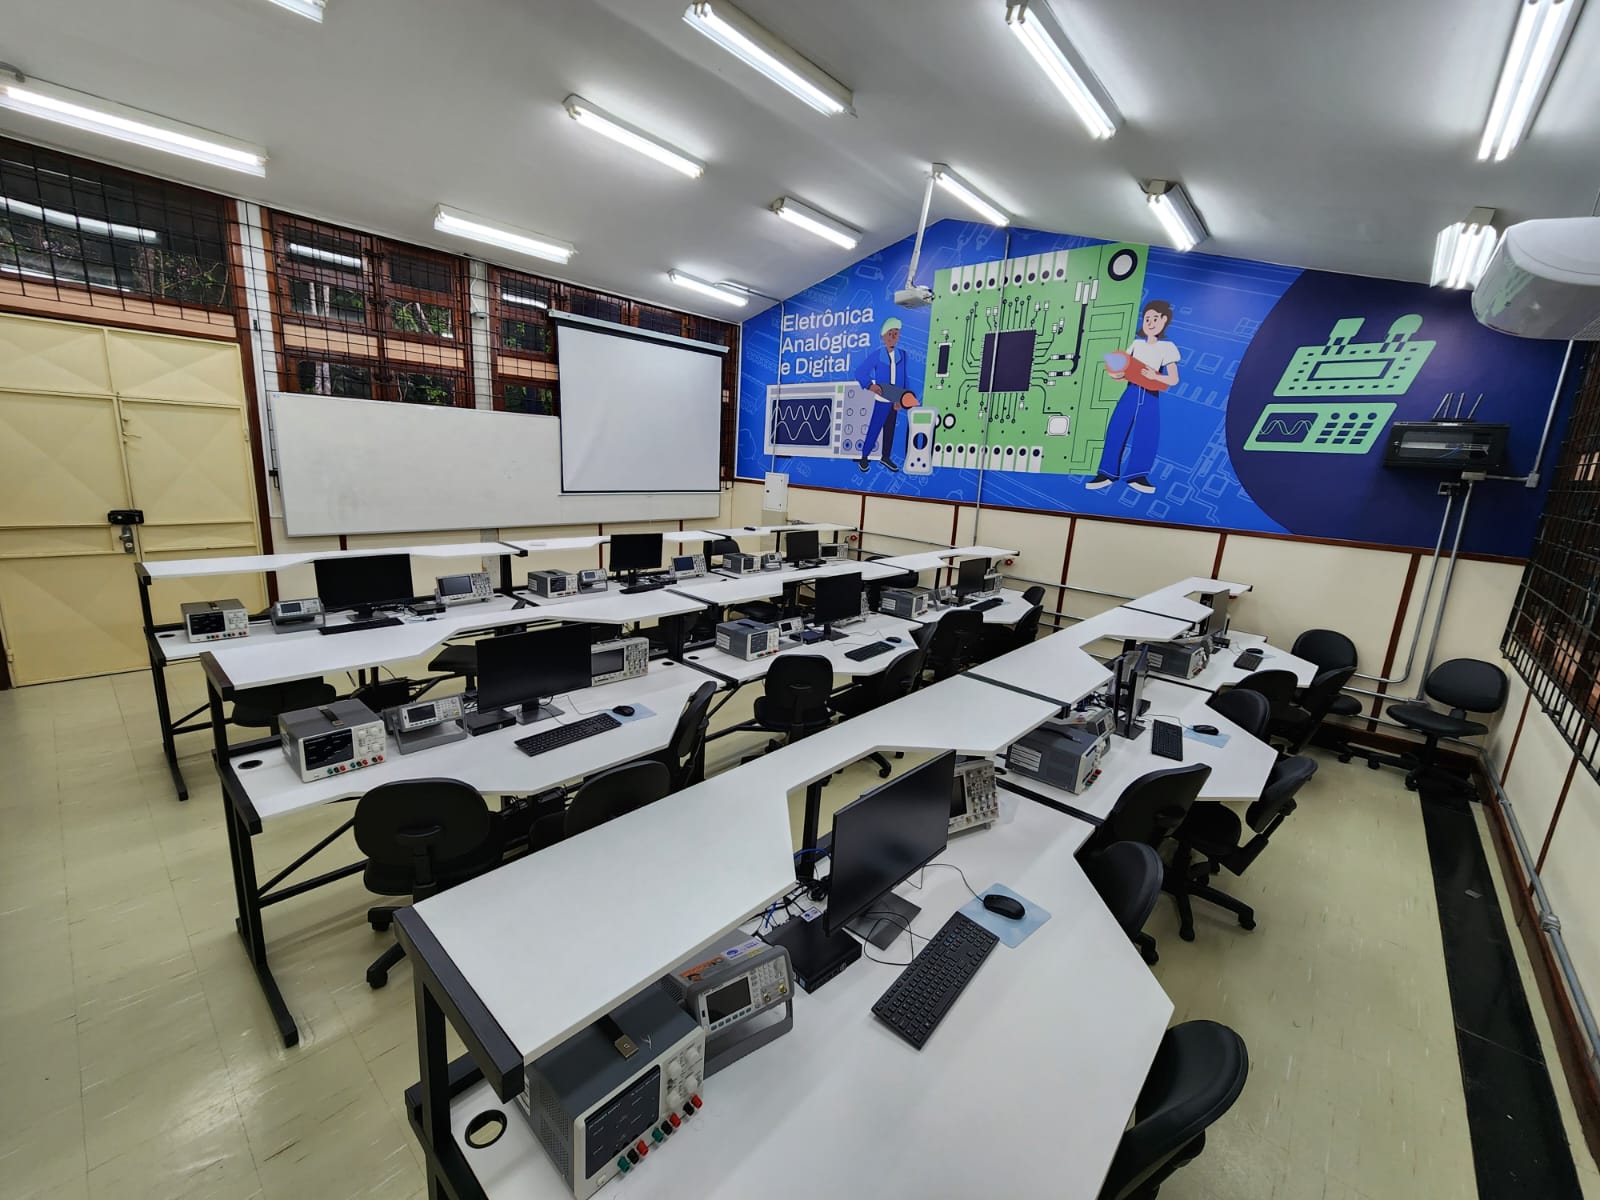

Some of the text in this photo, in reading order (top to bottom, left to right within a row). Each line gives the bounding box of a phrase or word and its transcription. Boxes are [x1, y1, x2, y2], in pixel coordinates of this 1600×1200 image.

[783, 306, 874, 332] Eletrônica
[782, 331, 870, 353] Analógica
[781, 353, 850, 377] e Digital
